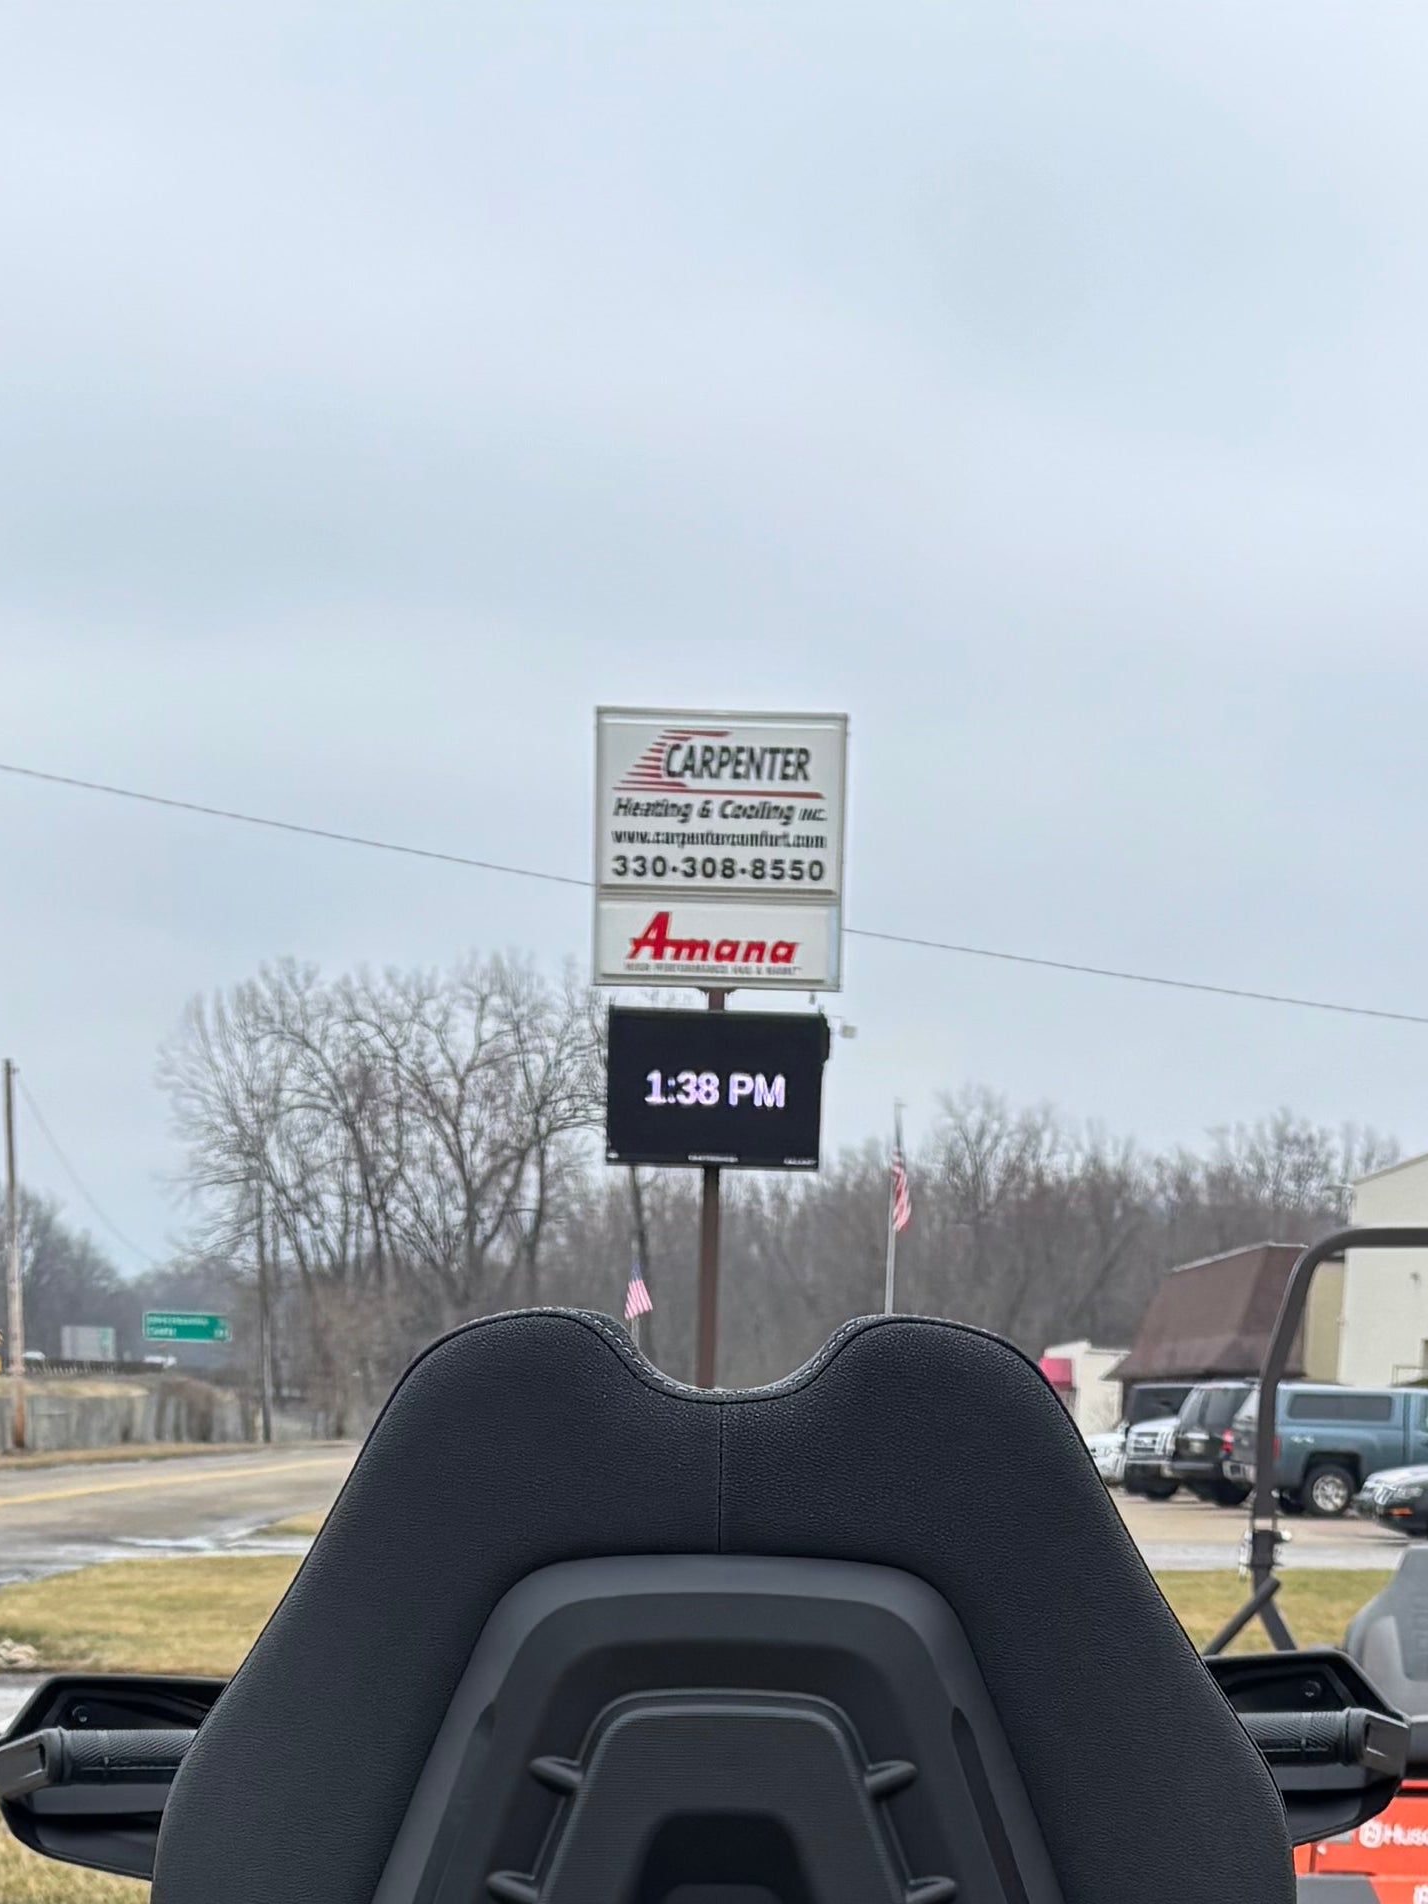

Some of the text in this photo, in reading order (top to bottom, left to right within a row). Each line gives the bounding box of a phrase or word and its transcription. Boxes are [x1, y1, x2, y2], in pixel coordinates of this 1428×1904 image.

[665, 743, 811, 781] CARPENTER
[613, 799, 693, 824] Heating
[697, 800, 713, 819] &
[719, 800, 795, 826] Cooling
[627, 911, 800, 964] Amana
[644, 1069, 786, 1108] 1:38 PM
